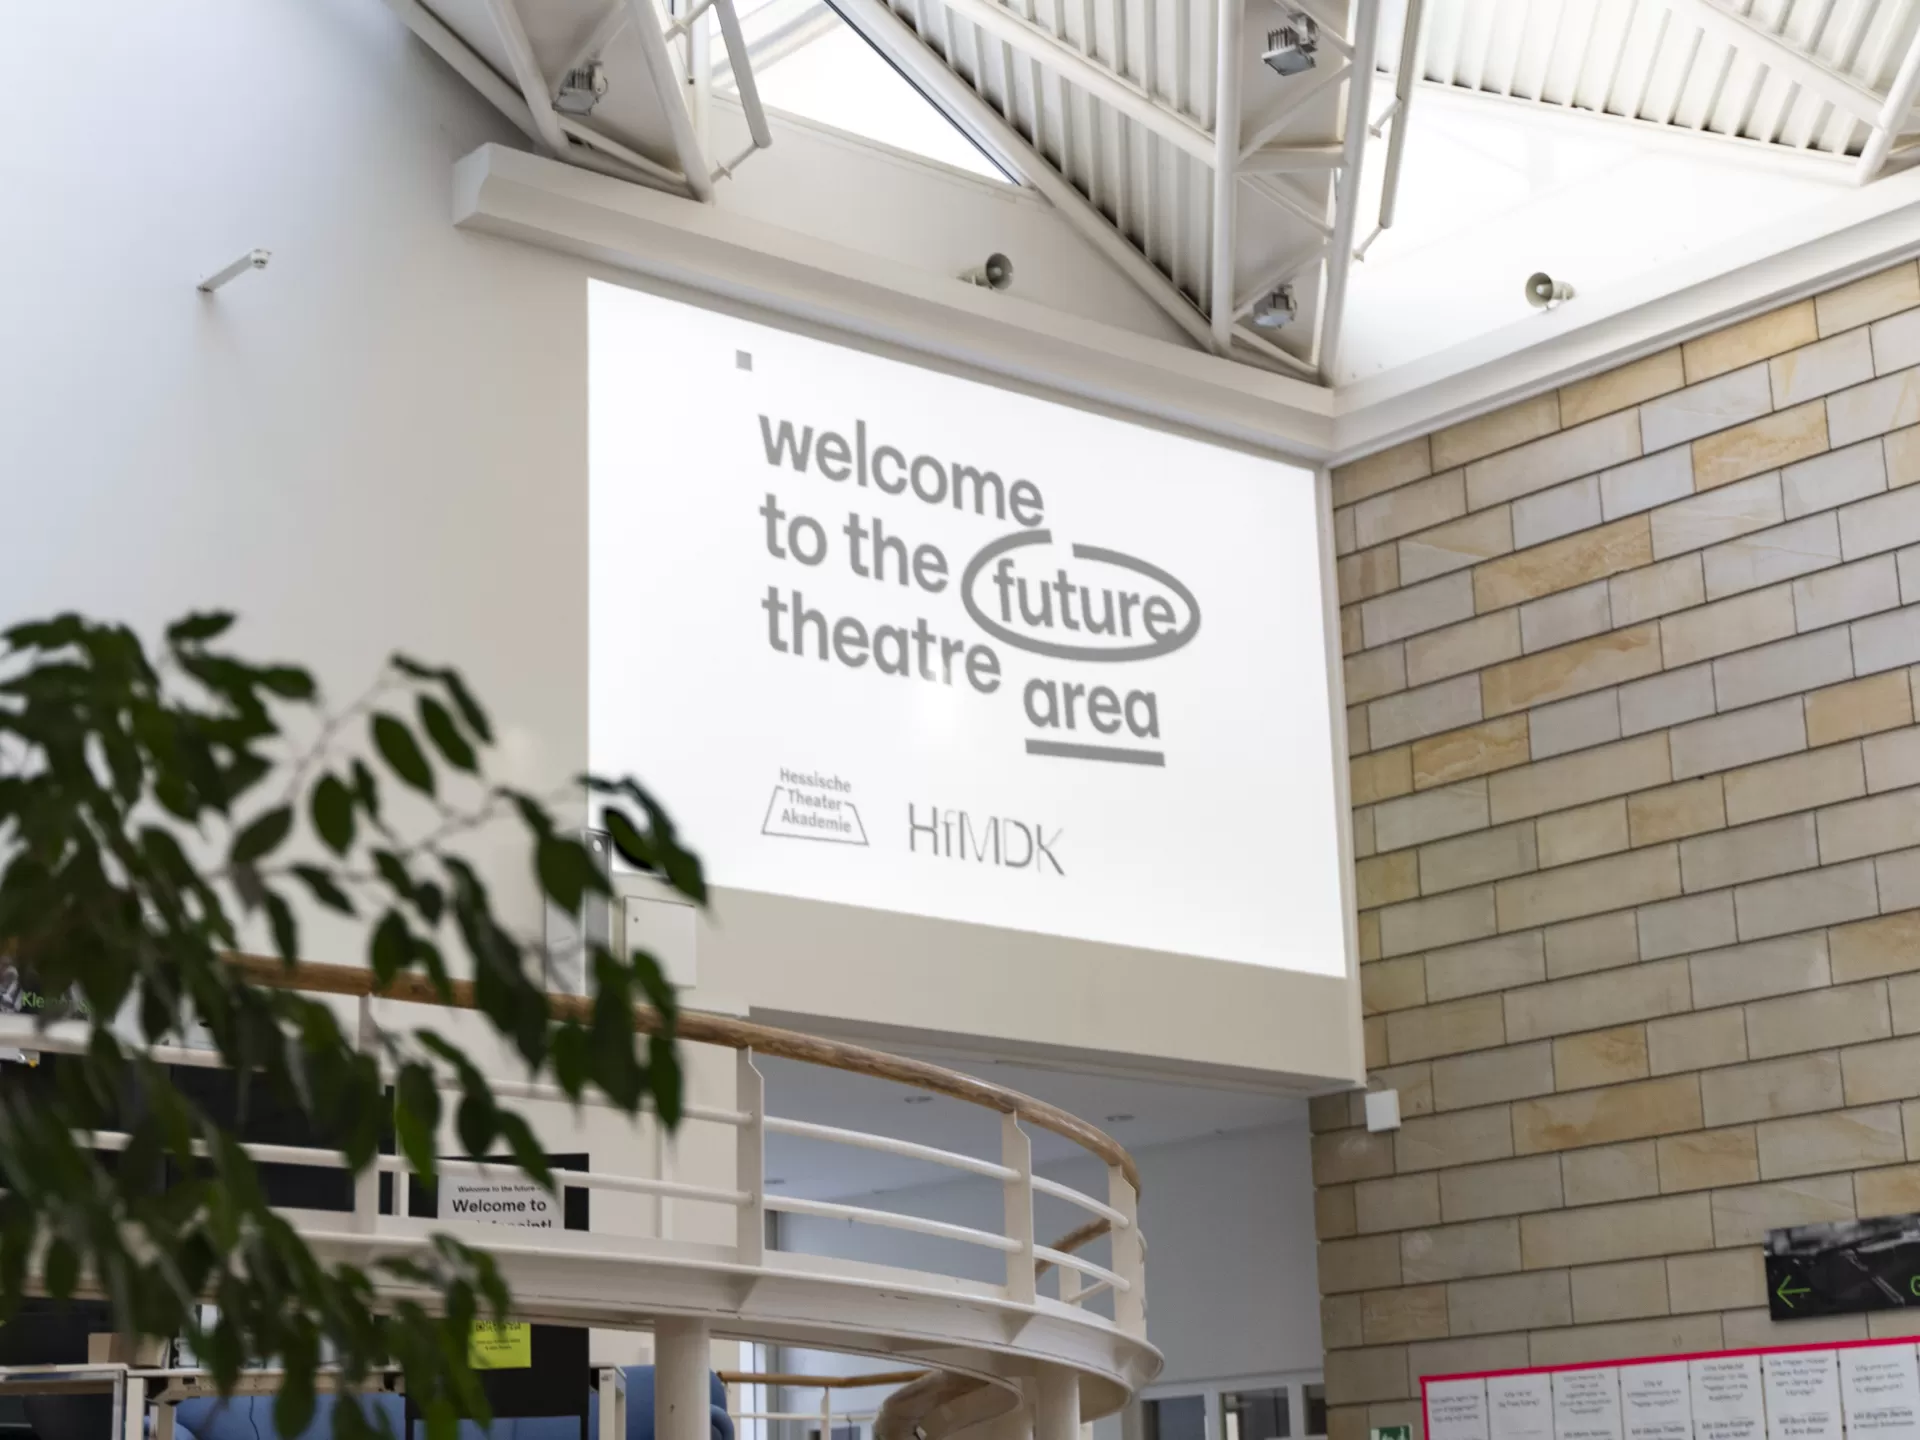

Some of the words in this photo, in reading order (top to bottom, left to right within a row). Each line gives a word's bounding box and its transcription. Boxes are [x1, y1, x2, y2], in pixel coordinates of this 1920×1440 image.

[758, 413, 1045, 528] welcome
[759, 492, 828, 566] to
[843, 512, 949, 593] the
[992, 559, 1178, 641] future
[761, 585, 1003, 694] theatre
[1023, 677, 1160, 739] area
[779, 767, 851, 793] Hessische
[788, 789, 842, 811] Theater
[781, 808, 851, 833] Akademie
[908, 801, 1066, 876] HfMDK
[452, 1199, 526, 1213] Welcome
[530, 1199, 547, 1212] to
[501, 1185, 513, 1193] the
